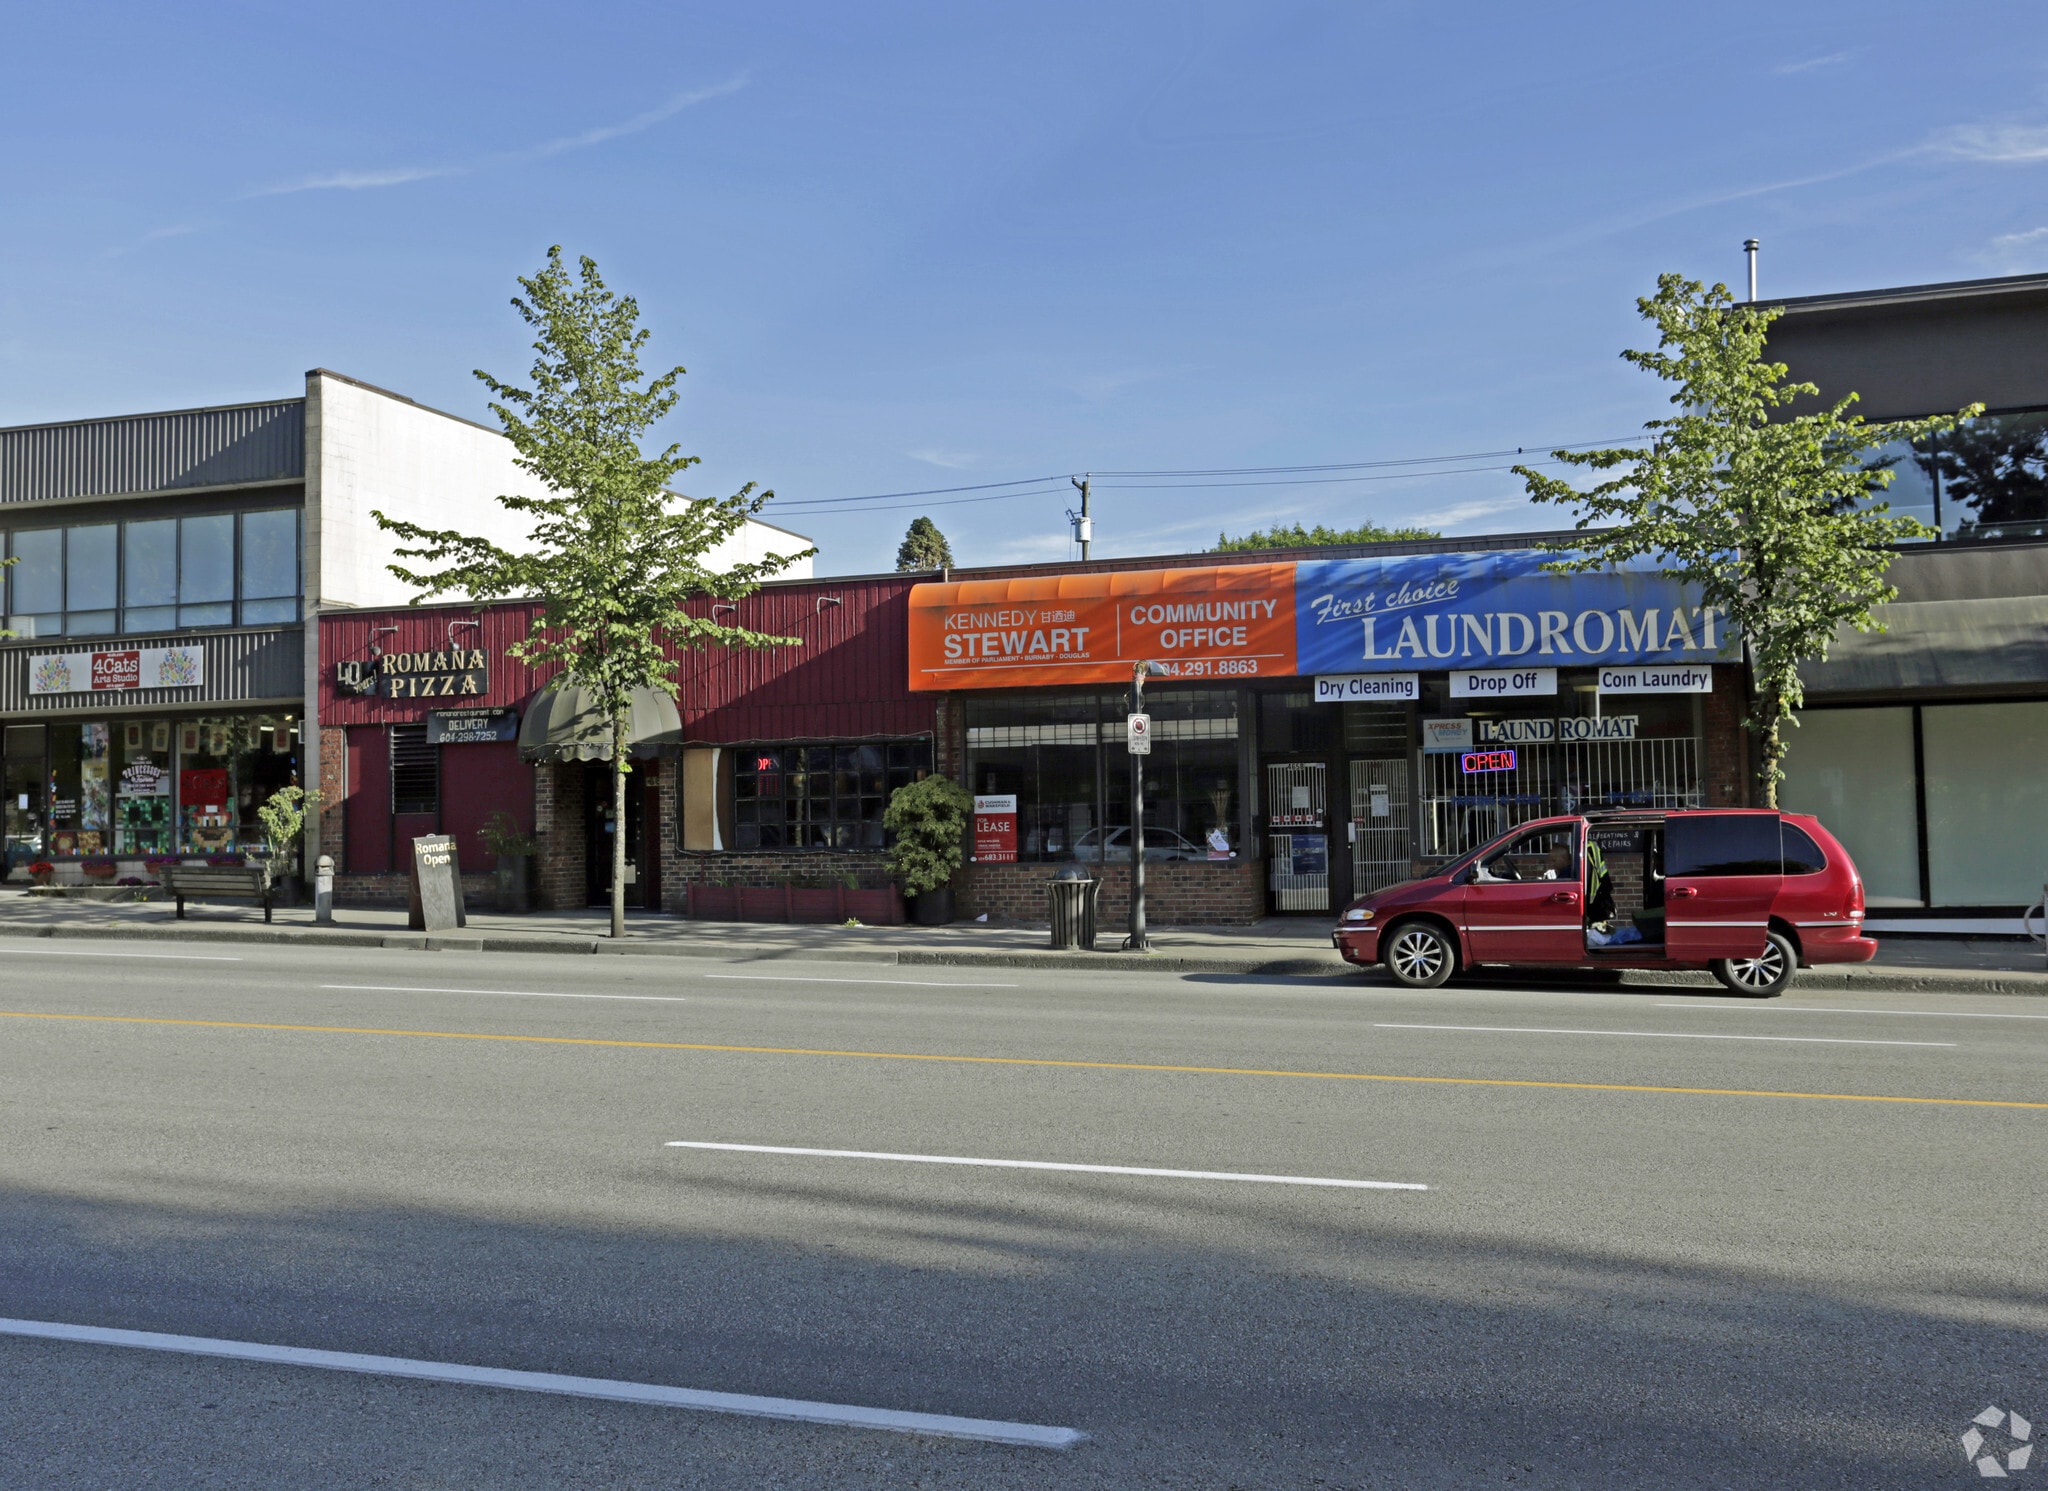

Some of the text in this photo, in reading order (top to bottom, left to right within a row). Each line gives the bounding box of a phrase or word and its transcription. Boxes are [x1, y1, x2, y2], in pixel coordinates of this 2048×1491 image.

[1130, 599, 1277, 625] COMMUNITY
[1310, 579, 1460, 626] First choice
[944, 609, 1037, 630] KENNEDY
[944, 627, 1090, 658] STEWART
[1160, 626, 1247, 649] OFFICE
[1361, 605, 1726, 660] LAUNDROMAT
[93, 657, 138, 674] 4Cats
[382, 649, 485, 675] ROMANA
[981, 655, 1020, 663] PARLIAMENT
[1024, 653, 1055, 661] BURNABY
[1162, 659, 1258, 677] 04.291.8863
[93, 673, 138, 684] Arts Studio
[337, 660, 361, 686] 40
[1468, 672, 1537, 693] Drop Off
[1602, 669, 1708, 690] Coin Laundry
[390, 674, 478, 698] PIZZA
[1319, 677, 1413, 699] Dry Cleaning
[448, 718, 489, 731] DELIVERY
[1427, 722, 1462, 730] XPRESS
[440, 731, 497, 743] 604-298-7252
[1463, 752, 1513, 771] OPEN
[977, 821, 1010, 832] LEASE
[416, 842, 457, 855] Romana
[423, 854, 451, 868] Open
